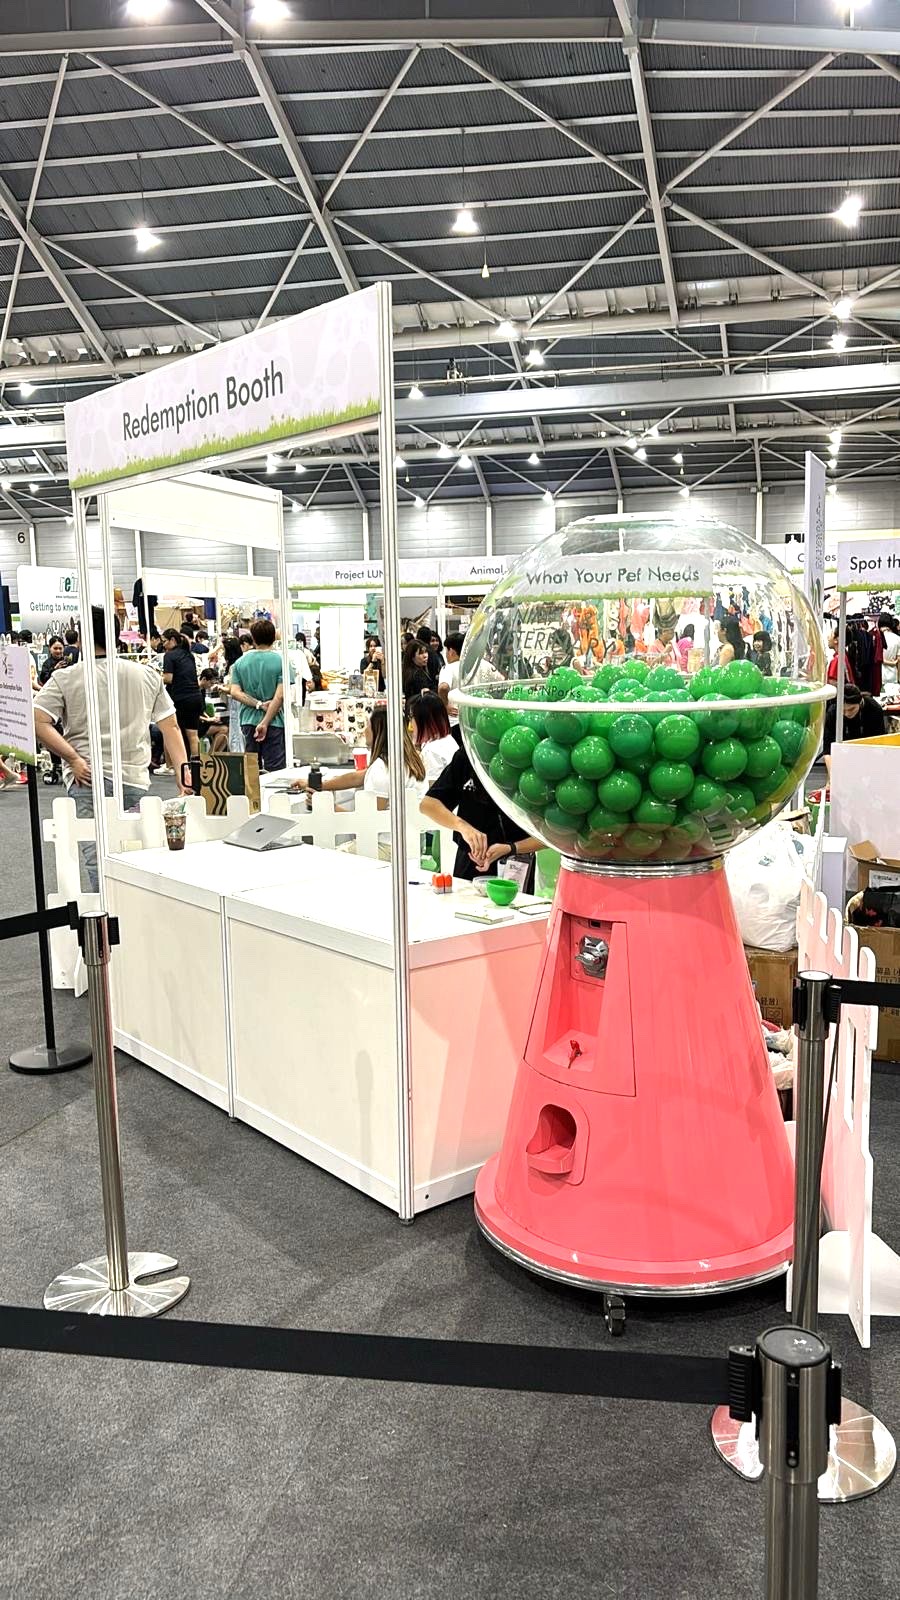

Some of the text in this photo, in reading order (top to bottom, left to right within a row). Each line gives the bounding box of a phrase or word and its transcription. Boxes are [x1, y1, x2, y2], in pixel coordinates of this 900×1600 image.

[122, 360, 284, 441] Redemption Booth
[17, 532, 26, 544] 6
[850, 556, 882, 573] Spot
[887, 554, 900, 569] th
[335, 570, 384, 581] Project LUN
[469, 565, 504, 575] Animal
[526, 566, 700, 585] What Your Pet Needs
[30, 602, 79, 613] Getting to know
